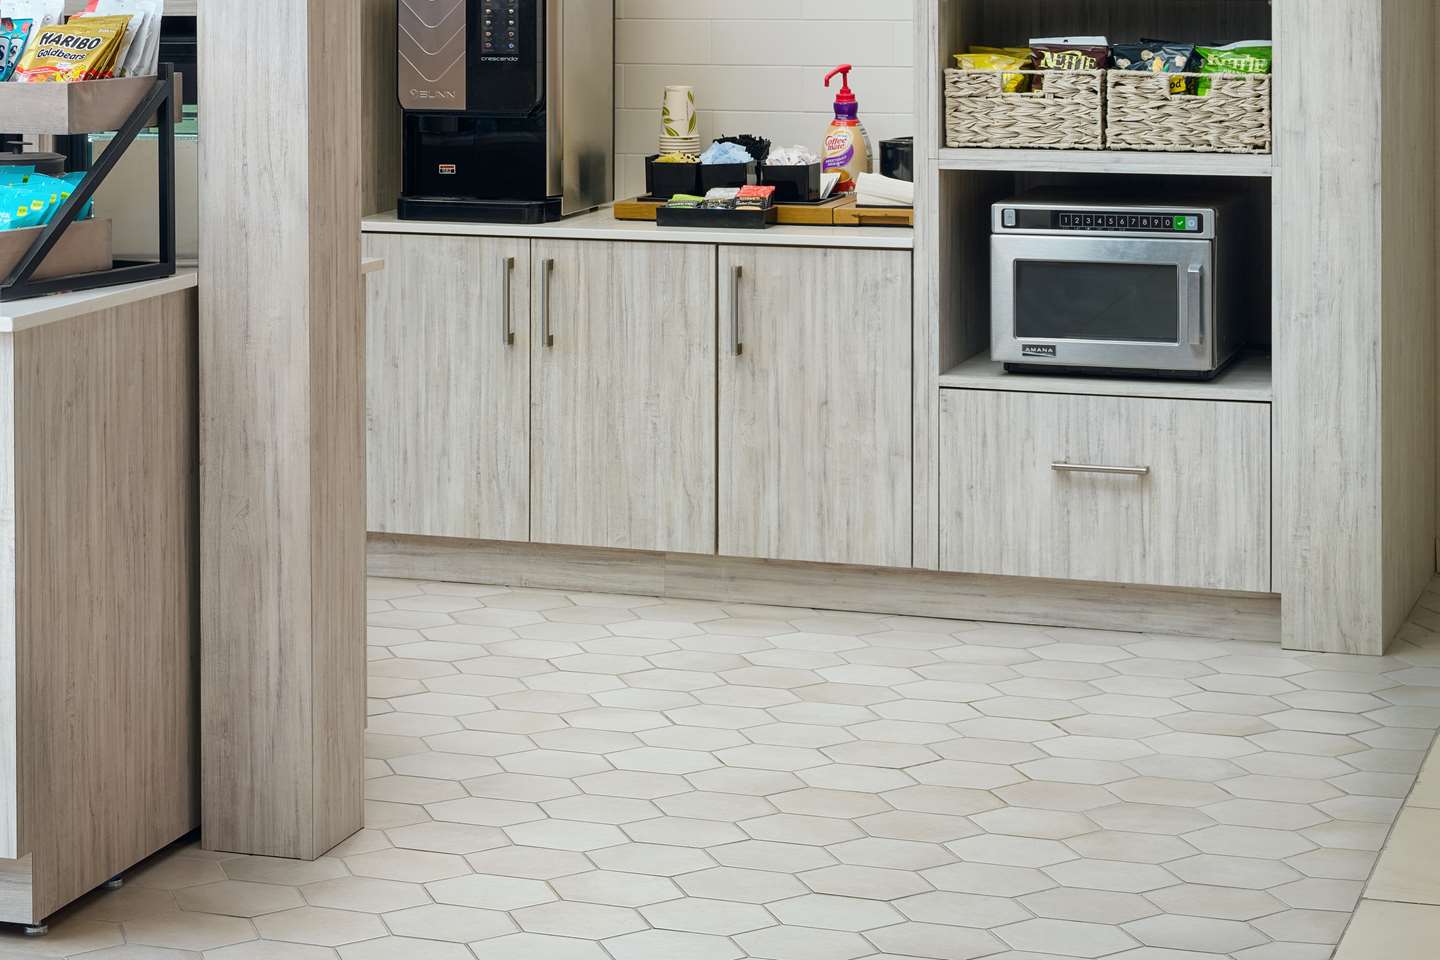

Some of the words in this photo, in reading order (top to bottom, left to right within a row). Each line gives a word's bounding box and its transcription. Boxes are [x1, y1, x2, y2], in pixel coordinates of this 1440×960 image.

[39, 32, 102, 51] HARIBO
[37, 49, 87, 60] Goldbears
[1025, 346, 1054, 354] AMANA
